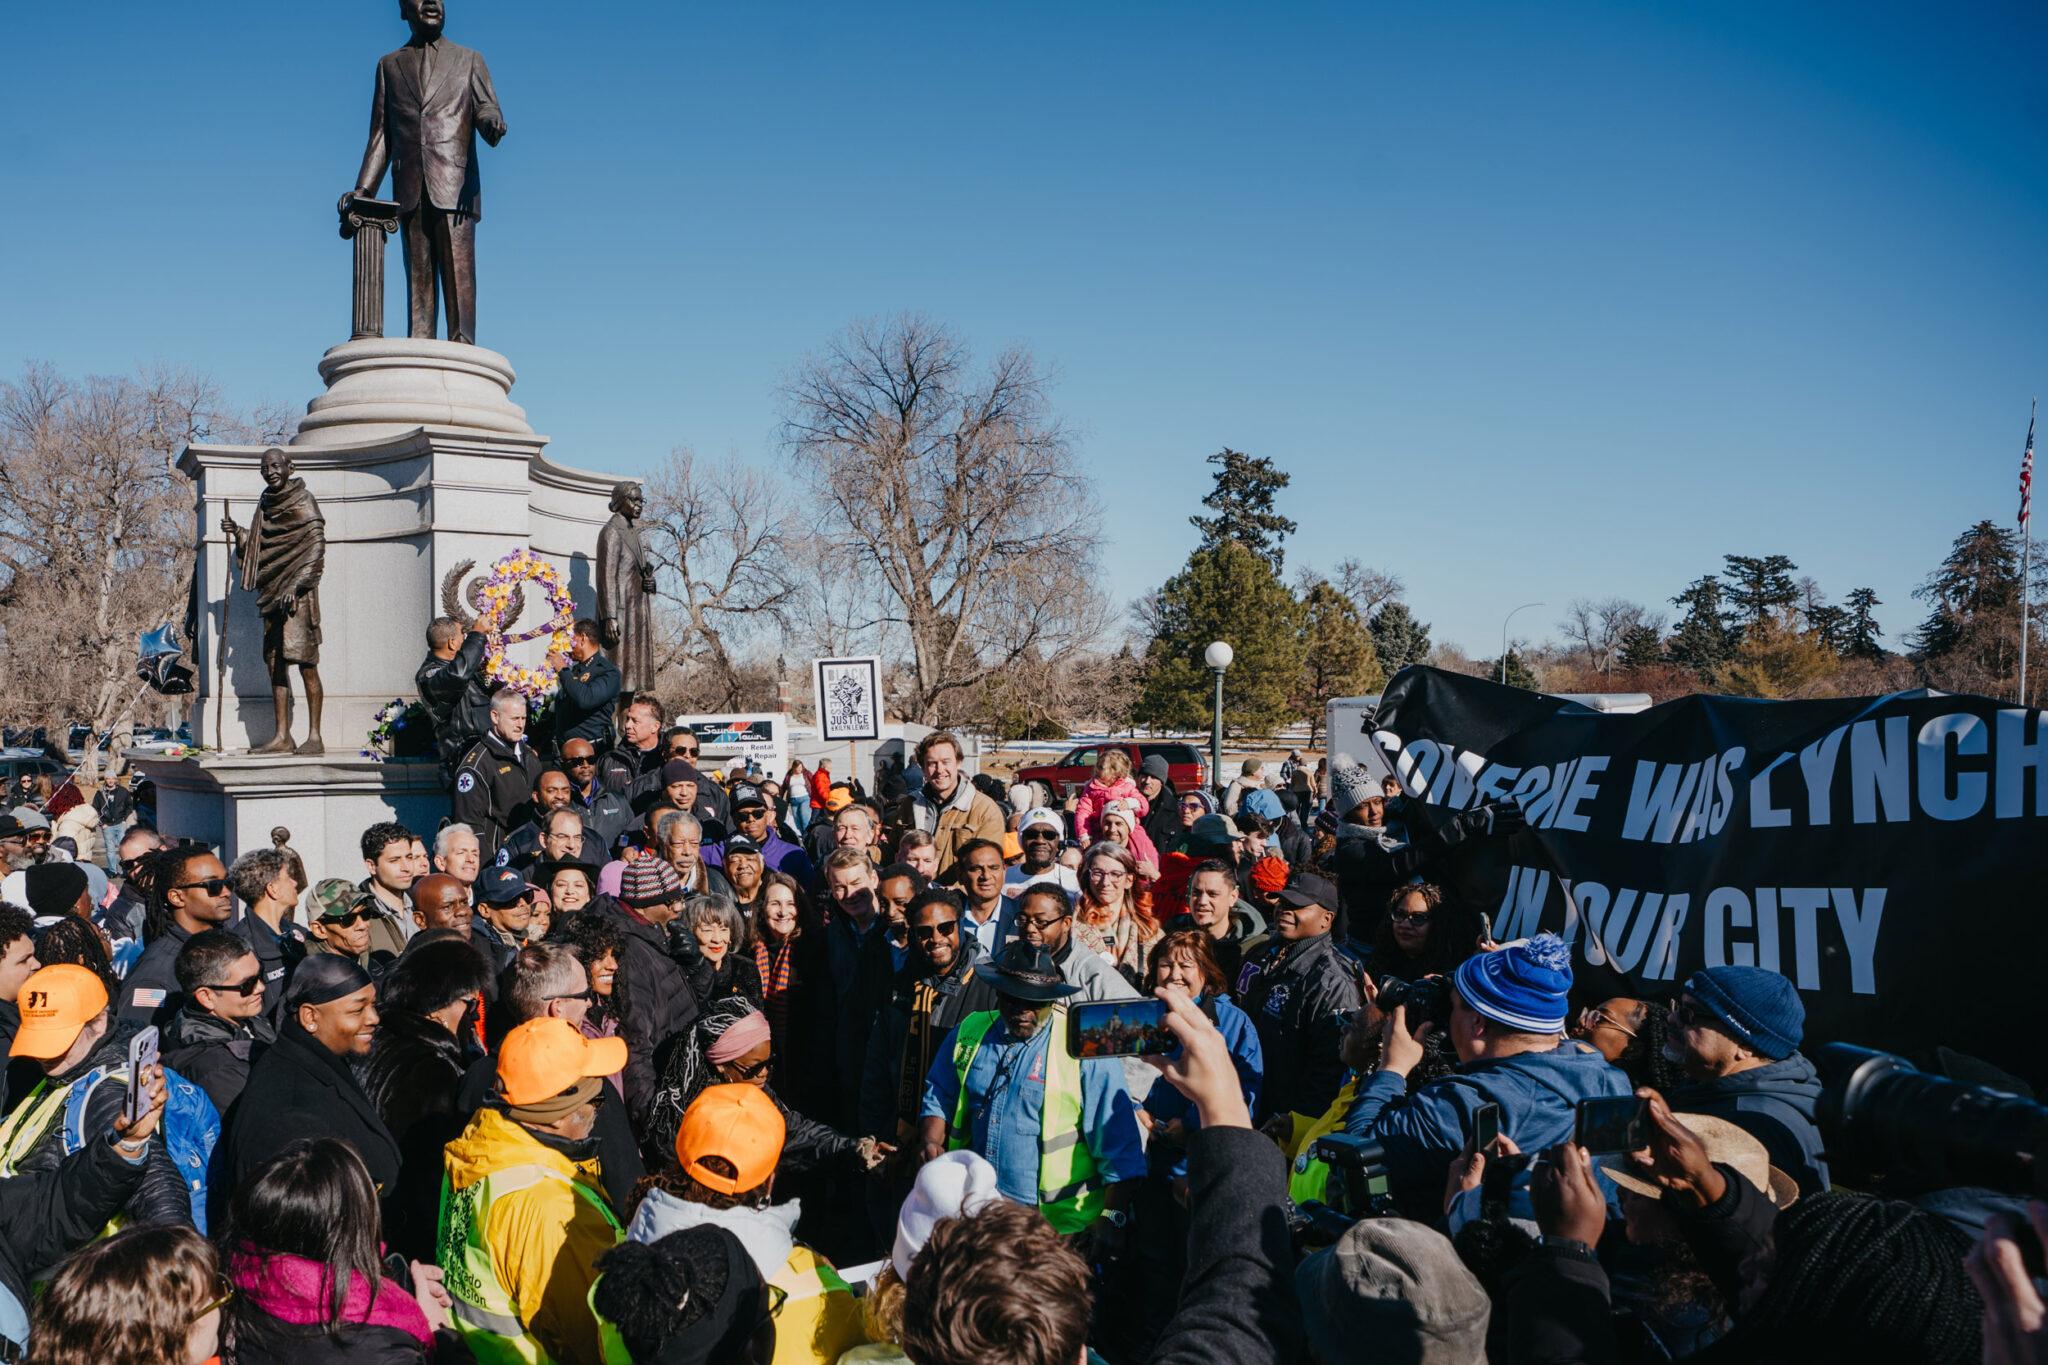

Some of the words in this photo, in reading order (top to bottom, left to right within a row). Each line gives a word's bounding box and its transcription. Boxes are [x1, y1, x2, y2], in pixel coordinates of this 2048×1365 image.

[830, 714, 869, 725] JUSTICE
[754, 752, 777, 760] Repair
[1621, 746, 1746, 844] WAS
[1492, 865, 1551, 942] IN
[1704, 887, 1888, 995] CITY
